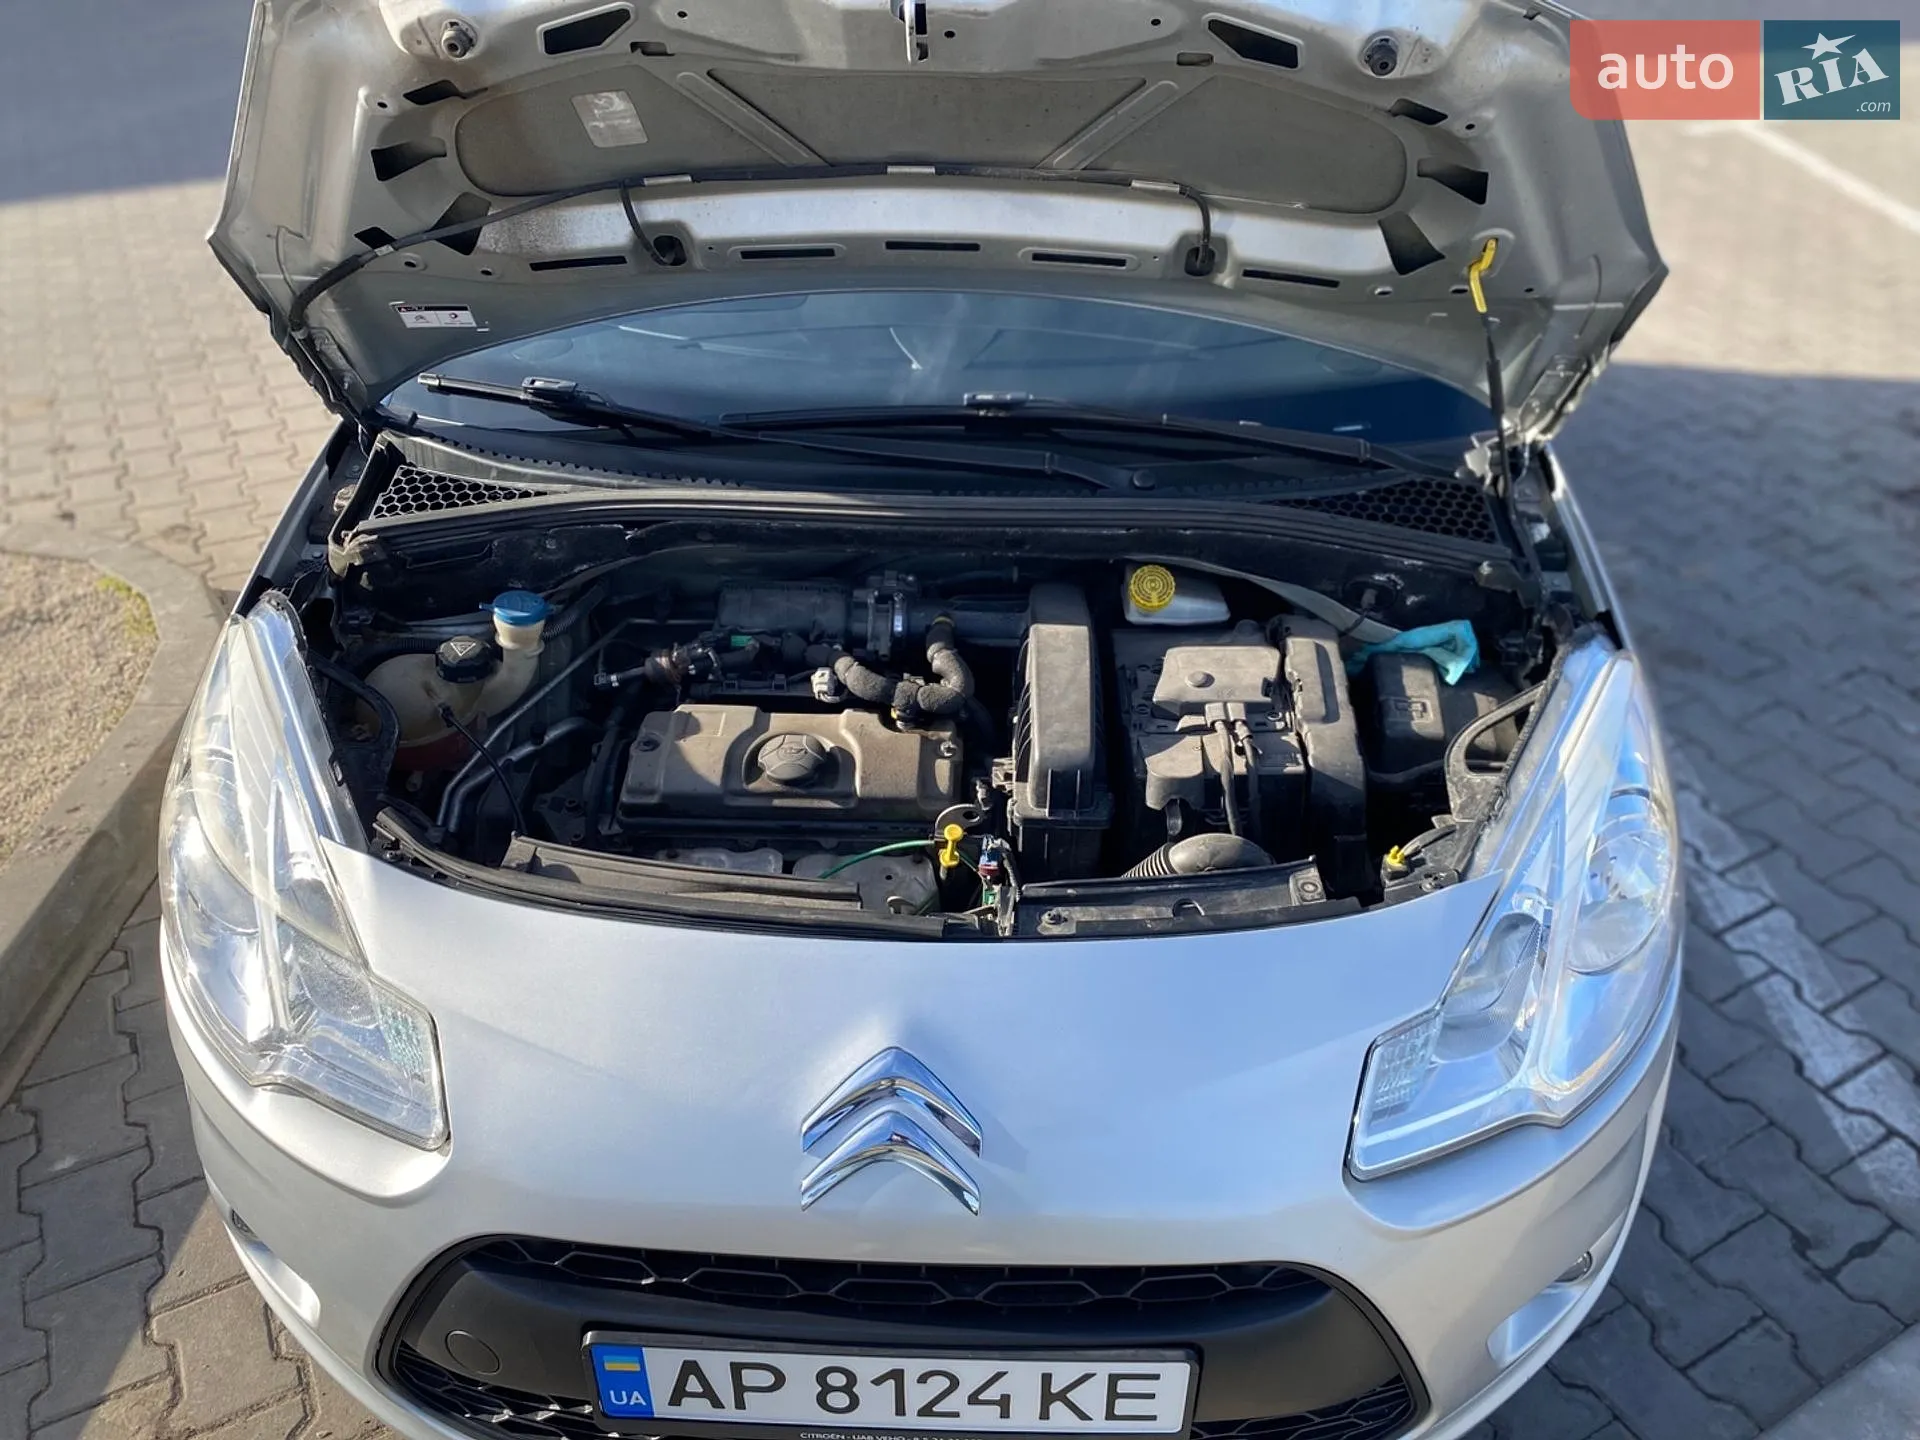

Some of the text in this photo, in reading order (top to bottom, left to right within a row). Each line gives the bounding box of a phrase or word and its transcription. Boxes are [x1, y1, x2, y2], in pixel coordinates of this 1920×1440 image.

[609, 1390, 647, 1405] UA
[668, 1360, 1161, 1421] AP 8124 KE
